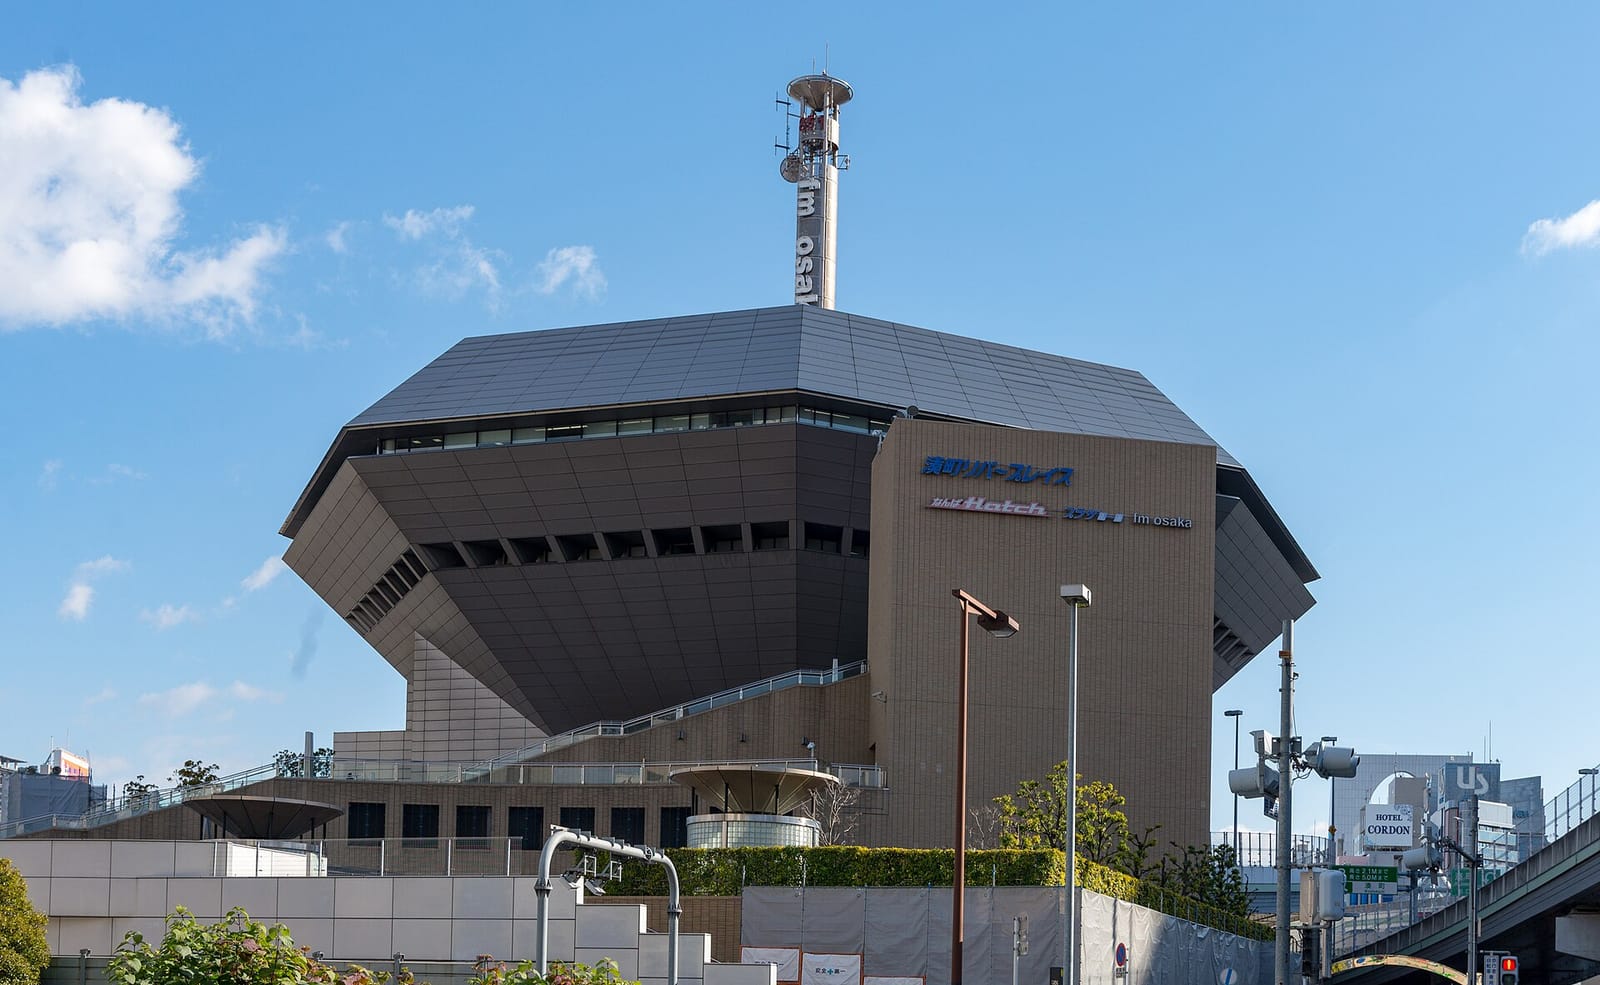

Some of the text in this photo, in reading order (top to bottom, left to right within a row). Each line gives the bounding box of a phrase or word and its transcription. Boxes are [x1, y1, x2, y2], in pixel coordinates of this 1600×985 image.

[798, 178, 821, 217] fm
[1153, 516, 1192, 528] osaka
[1367, 825, 1410, 835] CORDON
